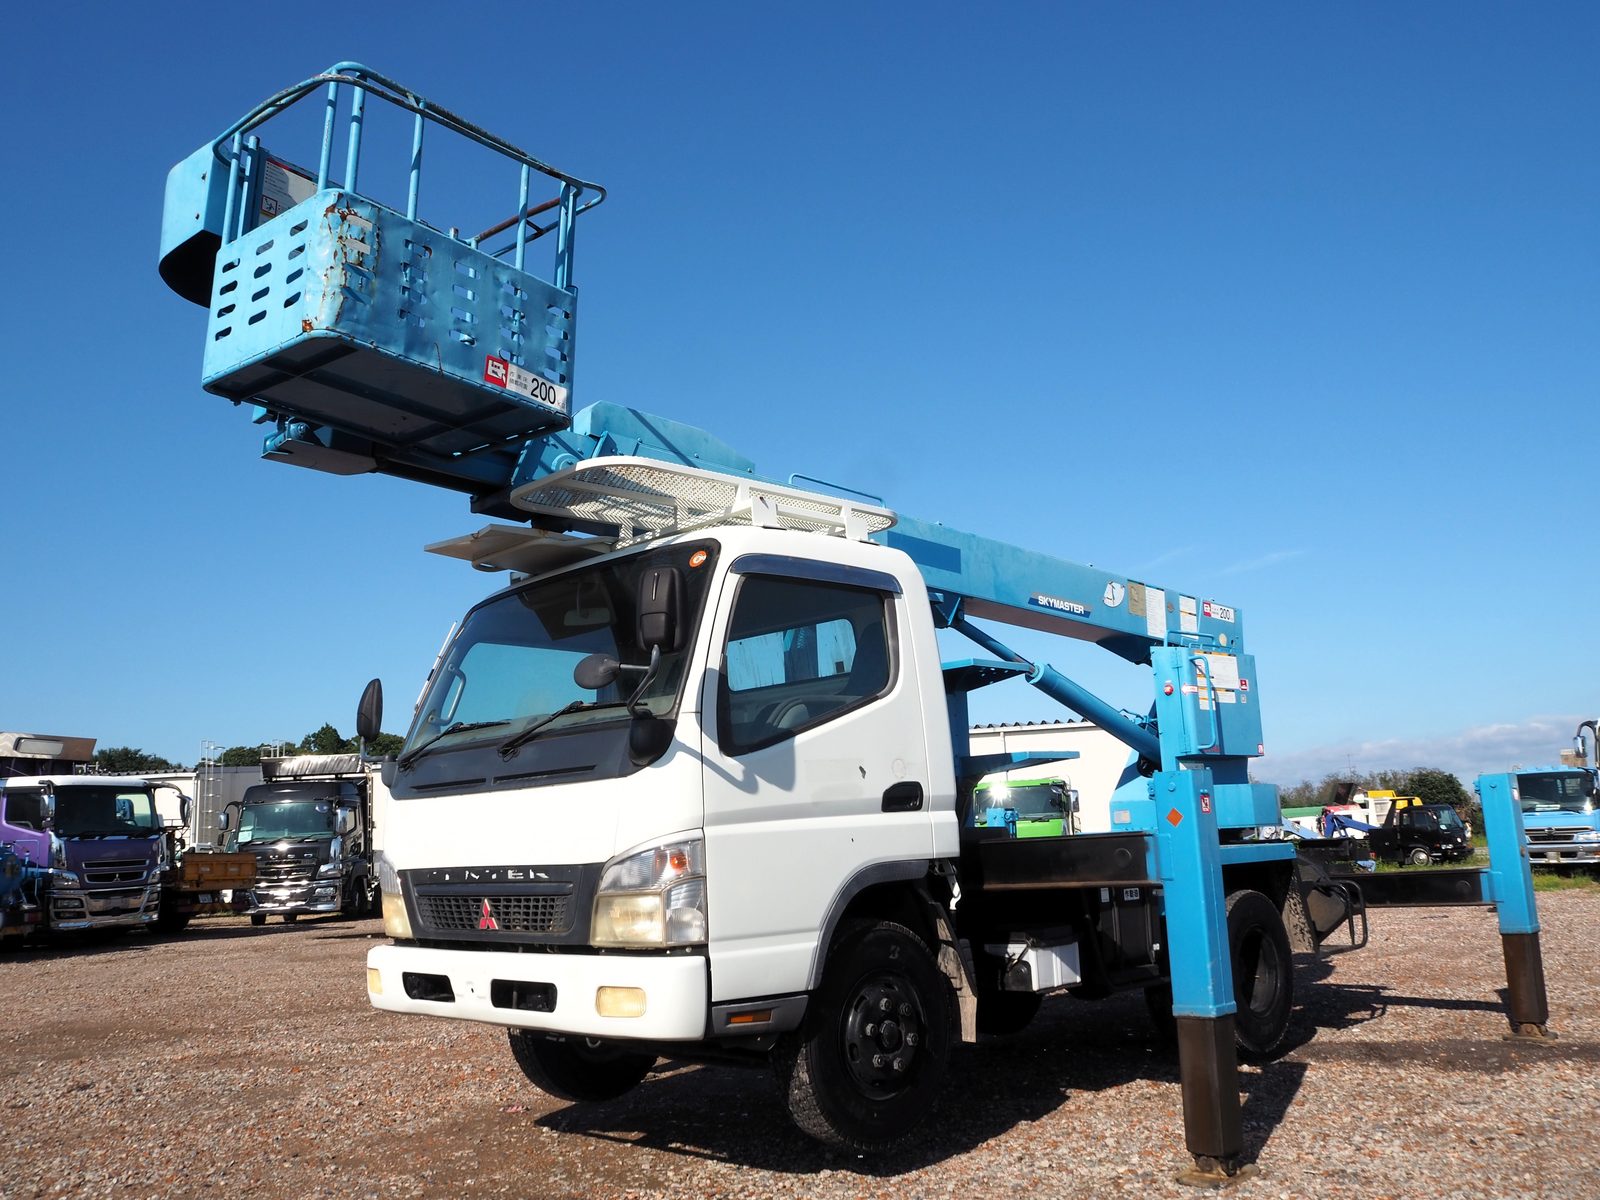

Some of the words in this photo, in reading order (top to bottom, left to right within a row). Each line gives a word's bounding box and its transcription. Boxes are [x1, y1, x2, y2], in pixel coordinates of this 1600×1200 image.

[530, 378, 556, 404] 200
[1038, 595, 1084, 614] SKYMASTER
[1219, 607, 1231, 621] 200
